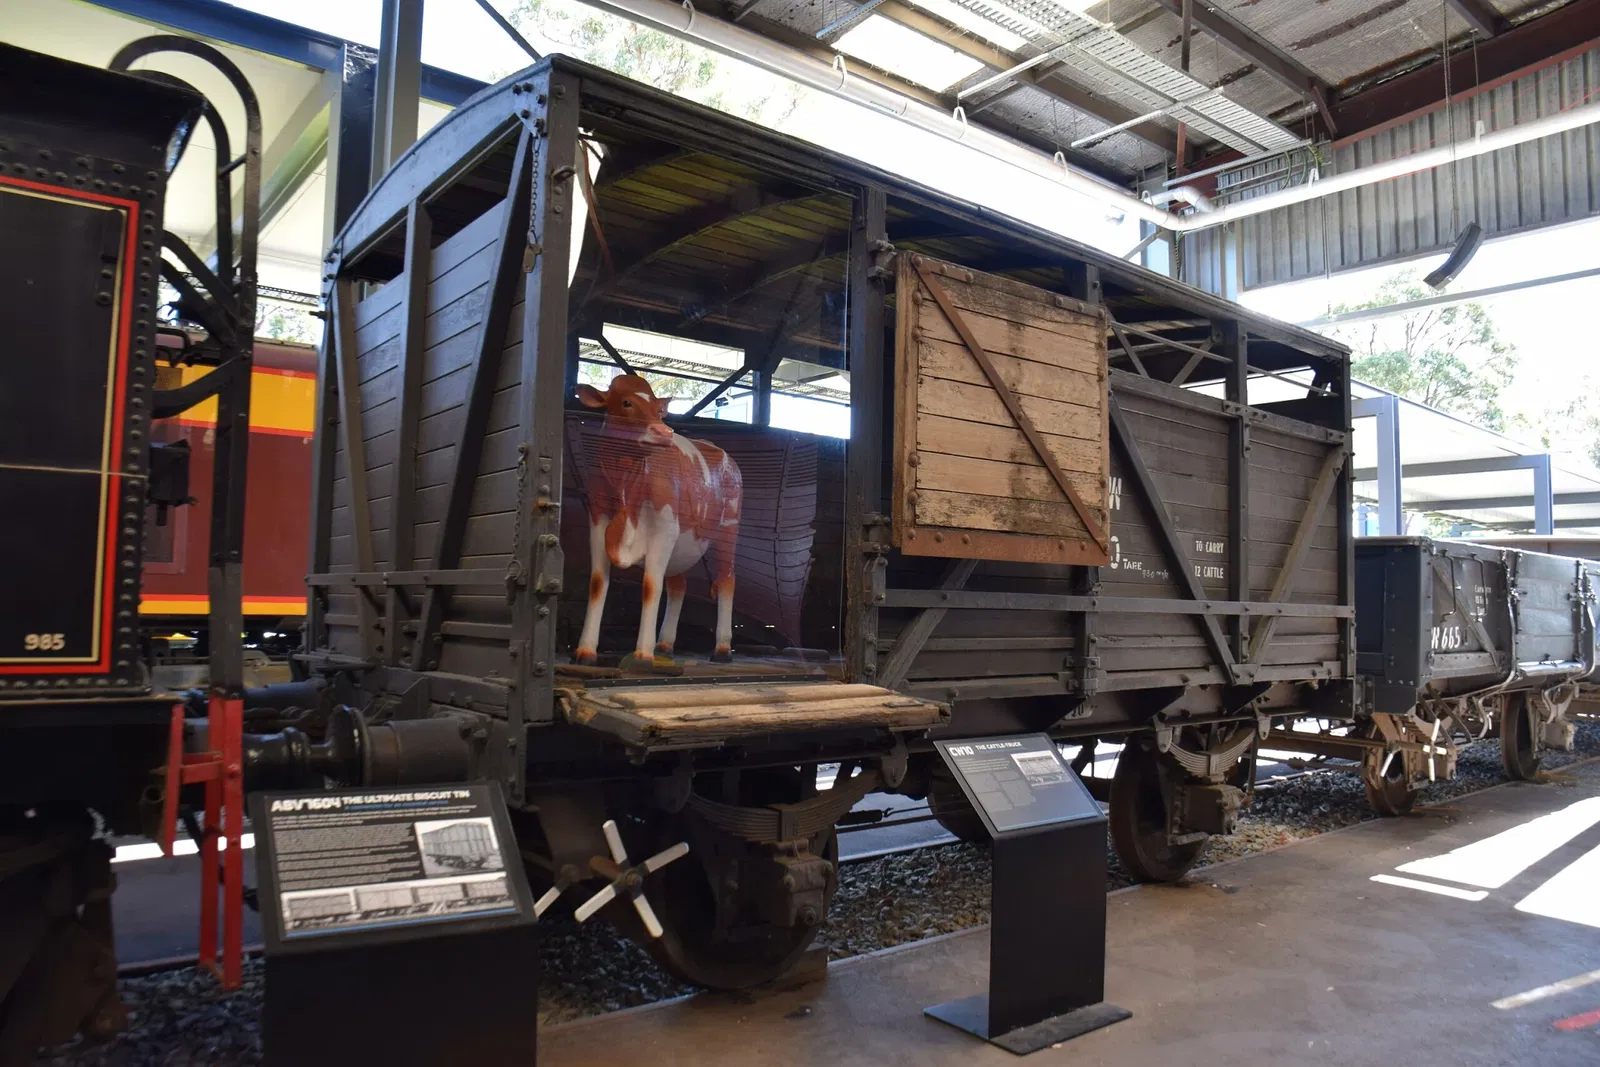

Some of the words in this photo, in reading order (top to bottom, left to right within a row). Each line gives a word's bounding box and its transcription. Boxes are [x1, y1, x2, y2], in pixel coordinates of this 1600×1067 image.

[1195, 540, 1203, 552] TO
[1205, 541, 1225, 554] CARRY
[1194, 565, 1201, 577] 12
[1203, 566, 1224, 579] CATTLE
[24, 633, 66, 651] 985
[1441, 626, 1461, 650] 665
[949, 746, 975, 756] CW10
[341, 794, 364, 805] THE
[364, 792, 413, 804] ULTIMATE
